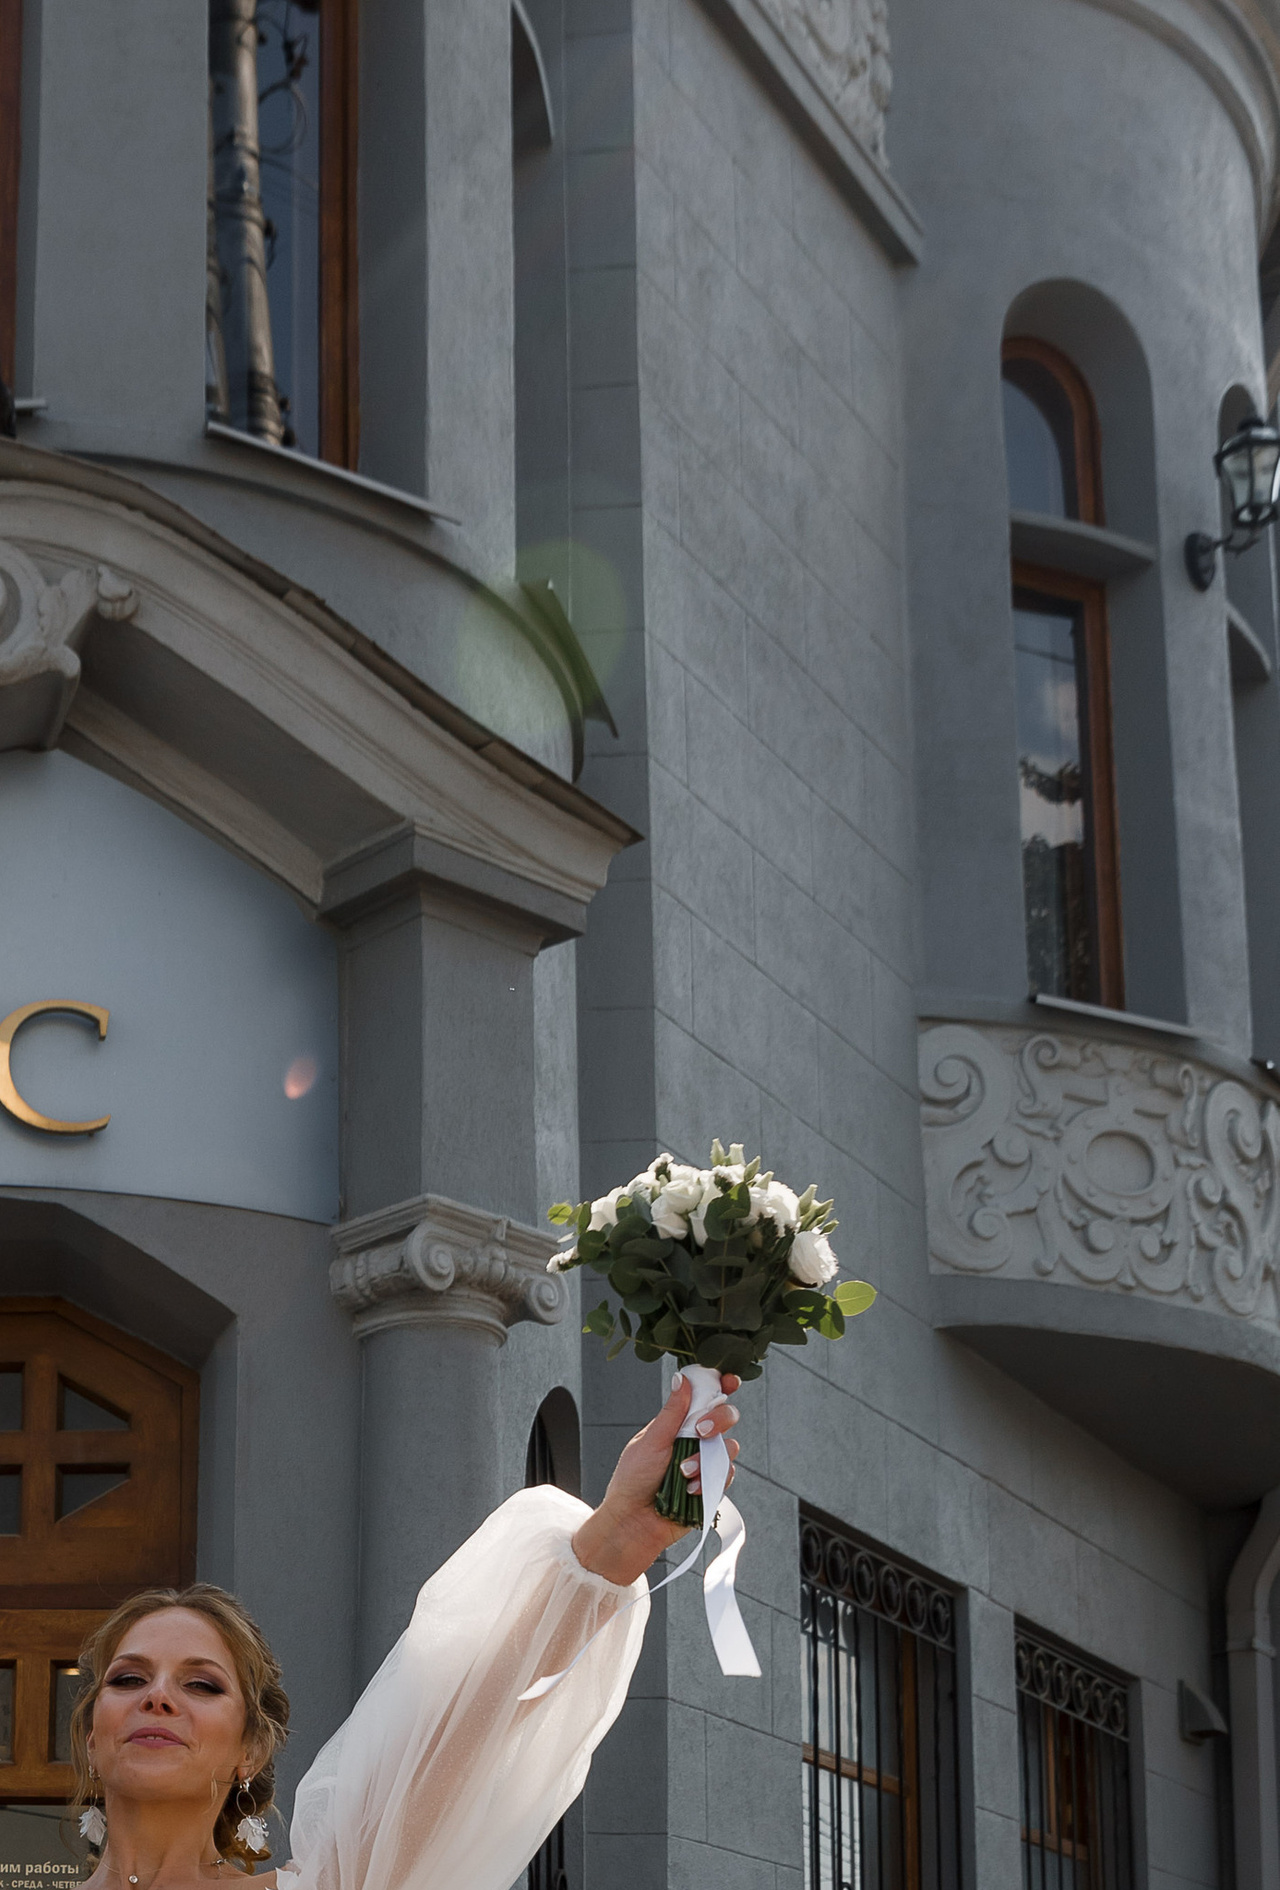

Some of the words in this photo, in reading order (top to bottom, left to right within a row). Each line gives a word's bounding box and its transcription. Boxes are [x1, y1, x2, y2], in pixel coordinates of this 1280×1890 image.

[25, 1862, 79, 1876] работы
[11, 1879, 43, 1889] СРЕДА
[52, 1881, 85, 1890] ЧЕТВЕ
